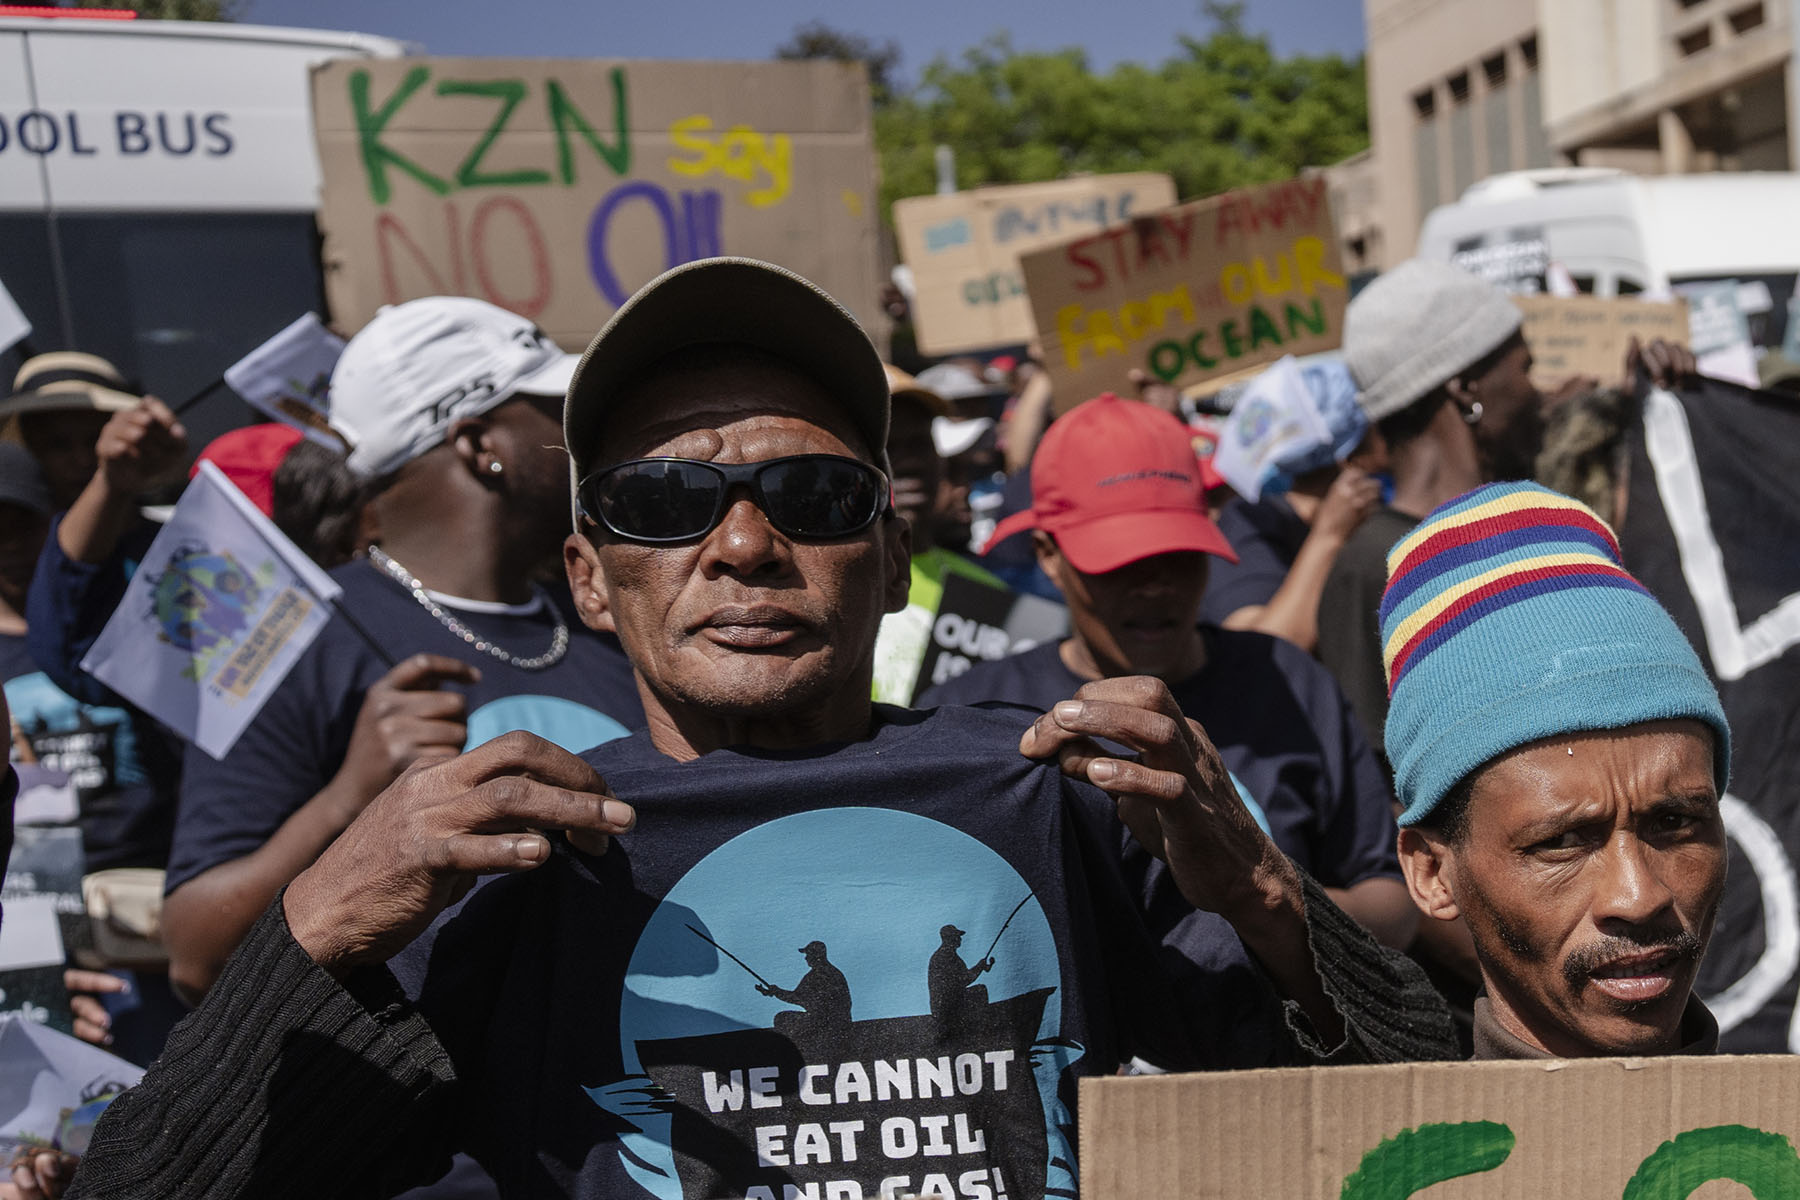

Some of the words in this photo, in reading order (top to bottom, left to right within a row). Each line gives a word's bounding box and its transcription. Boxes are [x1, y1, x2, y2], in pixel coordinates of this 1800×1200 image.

[0, 110, 97, 156] OL
[114, 111, 235, 157] BUS
[349, 66, 632, 205] KZN
[376, 196, 553, 317] NO
[1067, 214, 1193, 292] STAY
[1221, 236, 1345, 305] OUR
[1148, 297, 1328, 383] OCEAN
[702, 1066, 783, 1113] WE
[798, 1049, 1016, 1107] CANNOT
[755, 1120, 865, 1168] EAT
[880, 1112, 986, 1160] OIL
